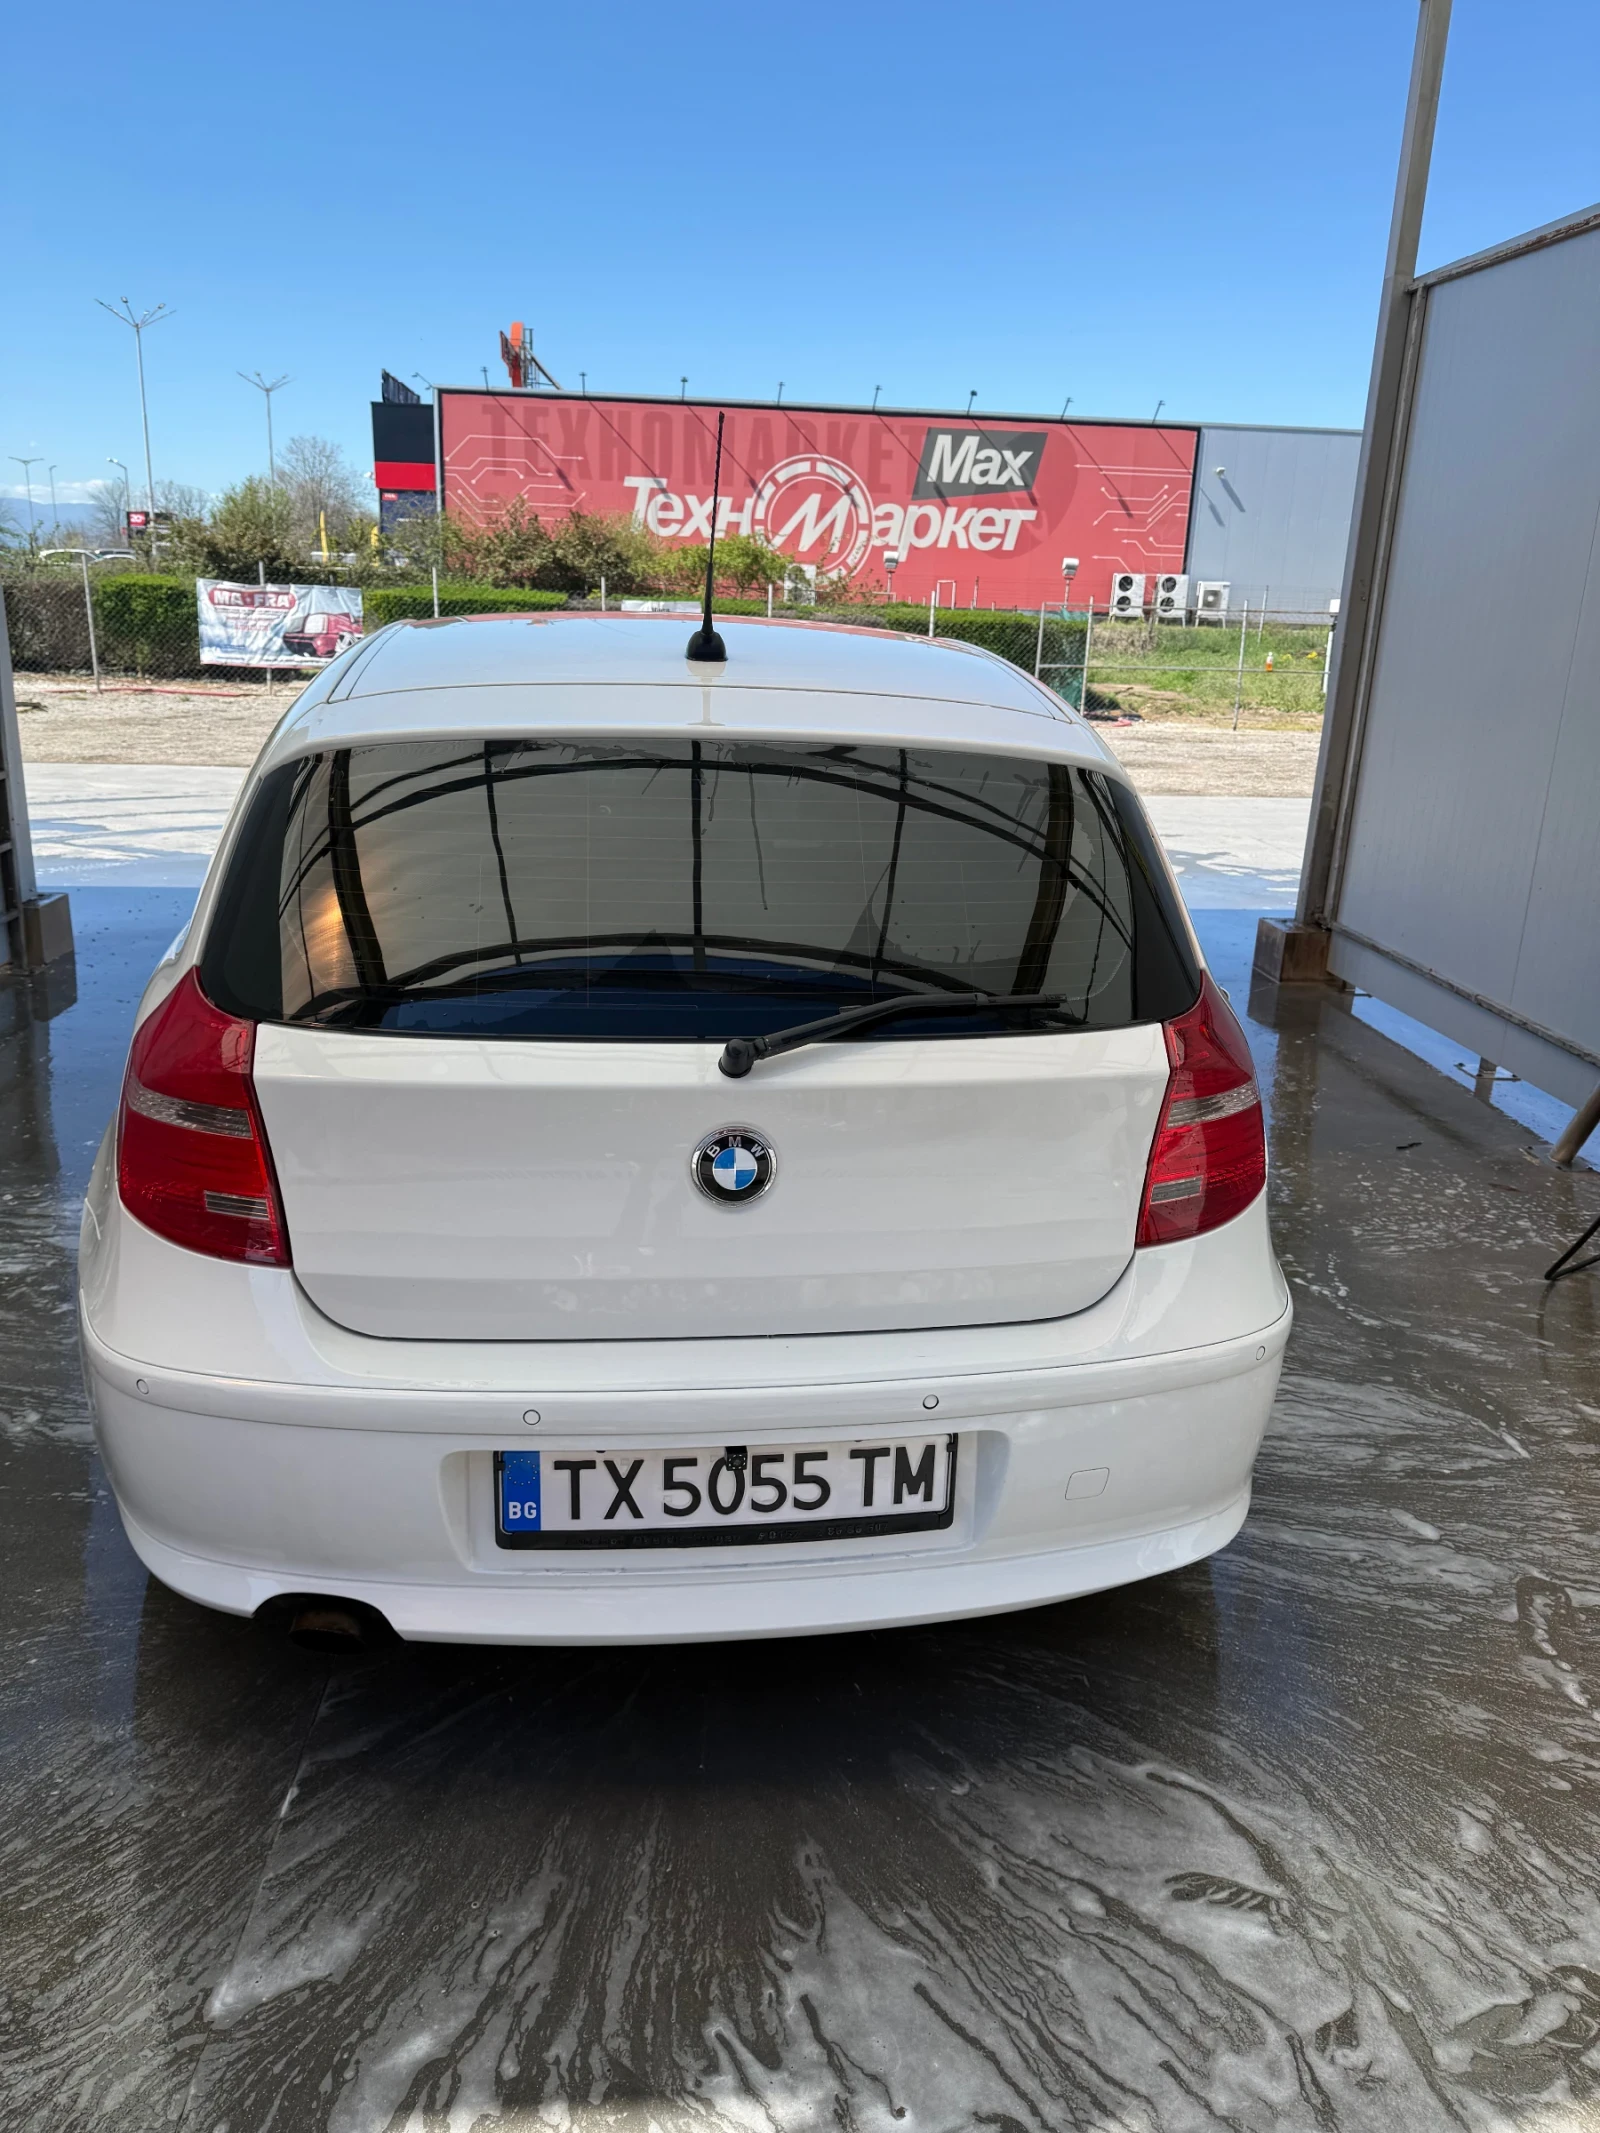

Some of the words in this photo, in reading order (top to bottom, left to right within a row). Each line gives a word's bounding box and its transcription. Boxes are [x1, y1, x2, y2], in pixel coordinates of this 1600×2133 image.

[926, 434, 1033, 486] Max
[706, 1136, 765, 1158] BMW
[553, 1459, 644, 1520] TX
[663, 1451, 831, 1516] 5055
[849, 1445, 936, 1507] TM
[508, 1501, 537, 1519] BG
